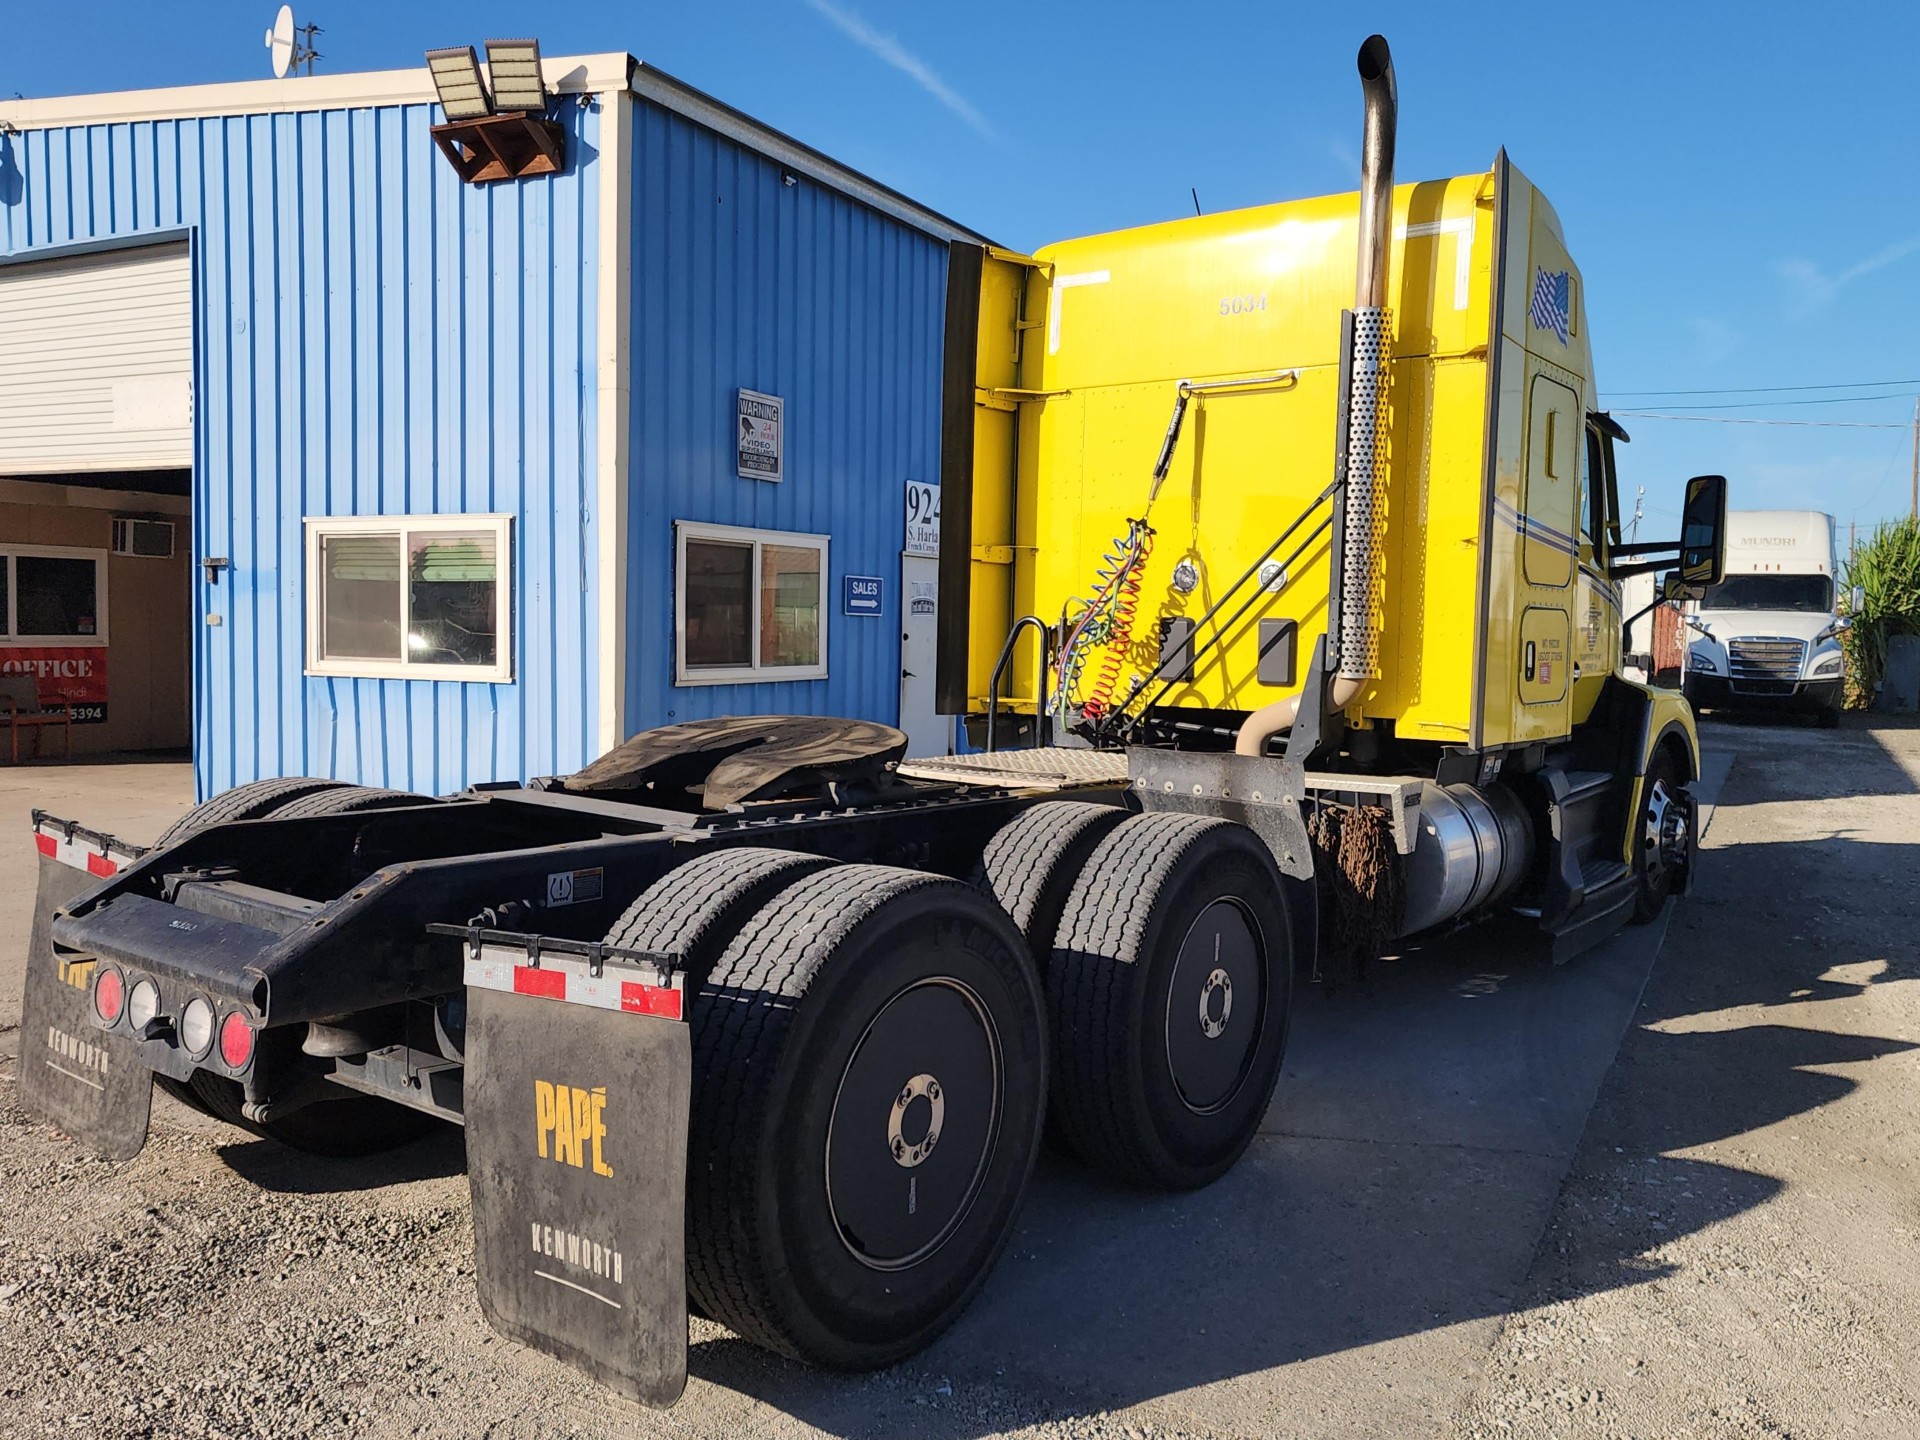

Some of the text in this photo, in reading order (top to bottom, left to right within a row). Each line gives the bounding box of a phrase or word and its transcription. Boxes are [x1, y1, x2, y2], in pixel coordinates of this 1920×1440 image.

[740, 400, 777, 420] WARNING
[763, 422, 772, 432] 24
[746, 439, 771, 450] VIDEO
[852, 581, 878, 596] SALES
[3, 660, 93, 678] OFFICE
[48, 1026, 109, 1073] KENWORTH
[532, 1223, 622, 1284] KENWORTH
